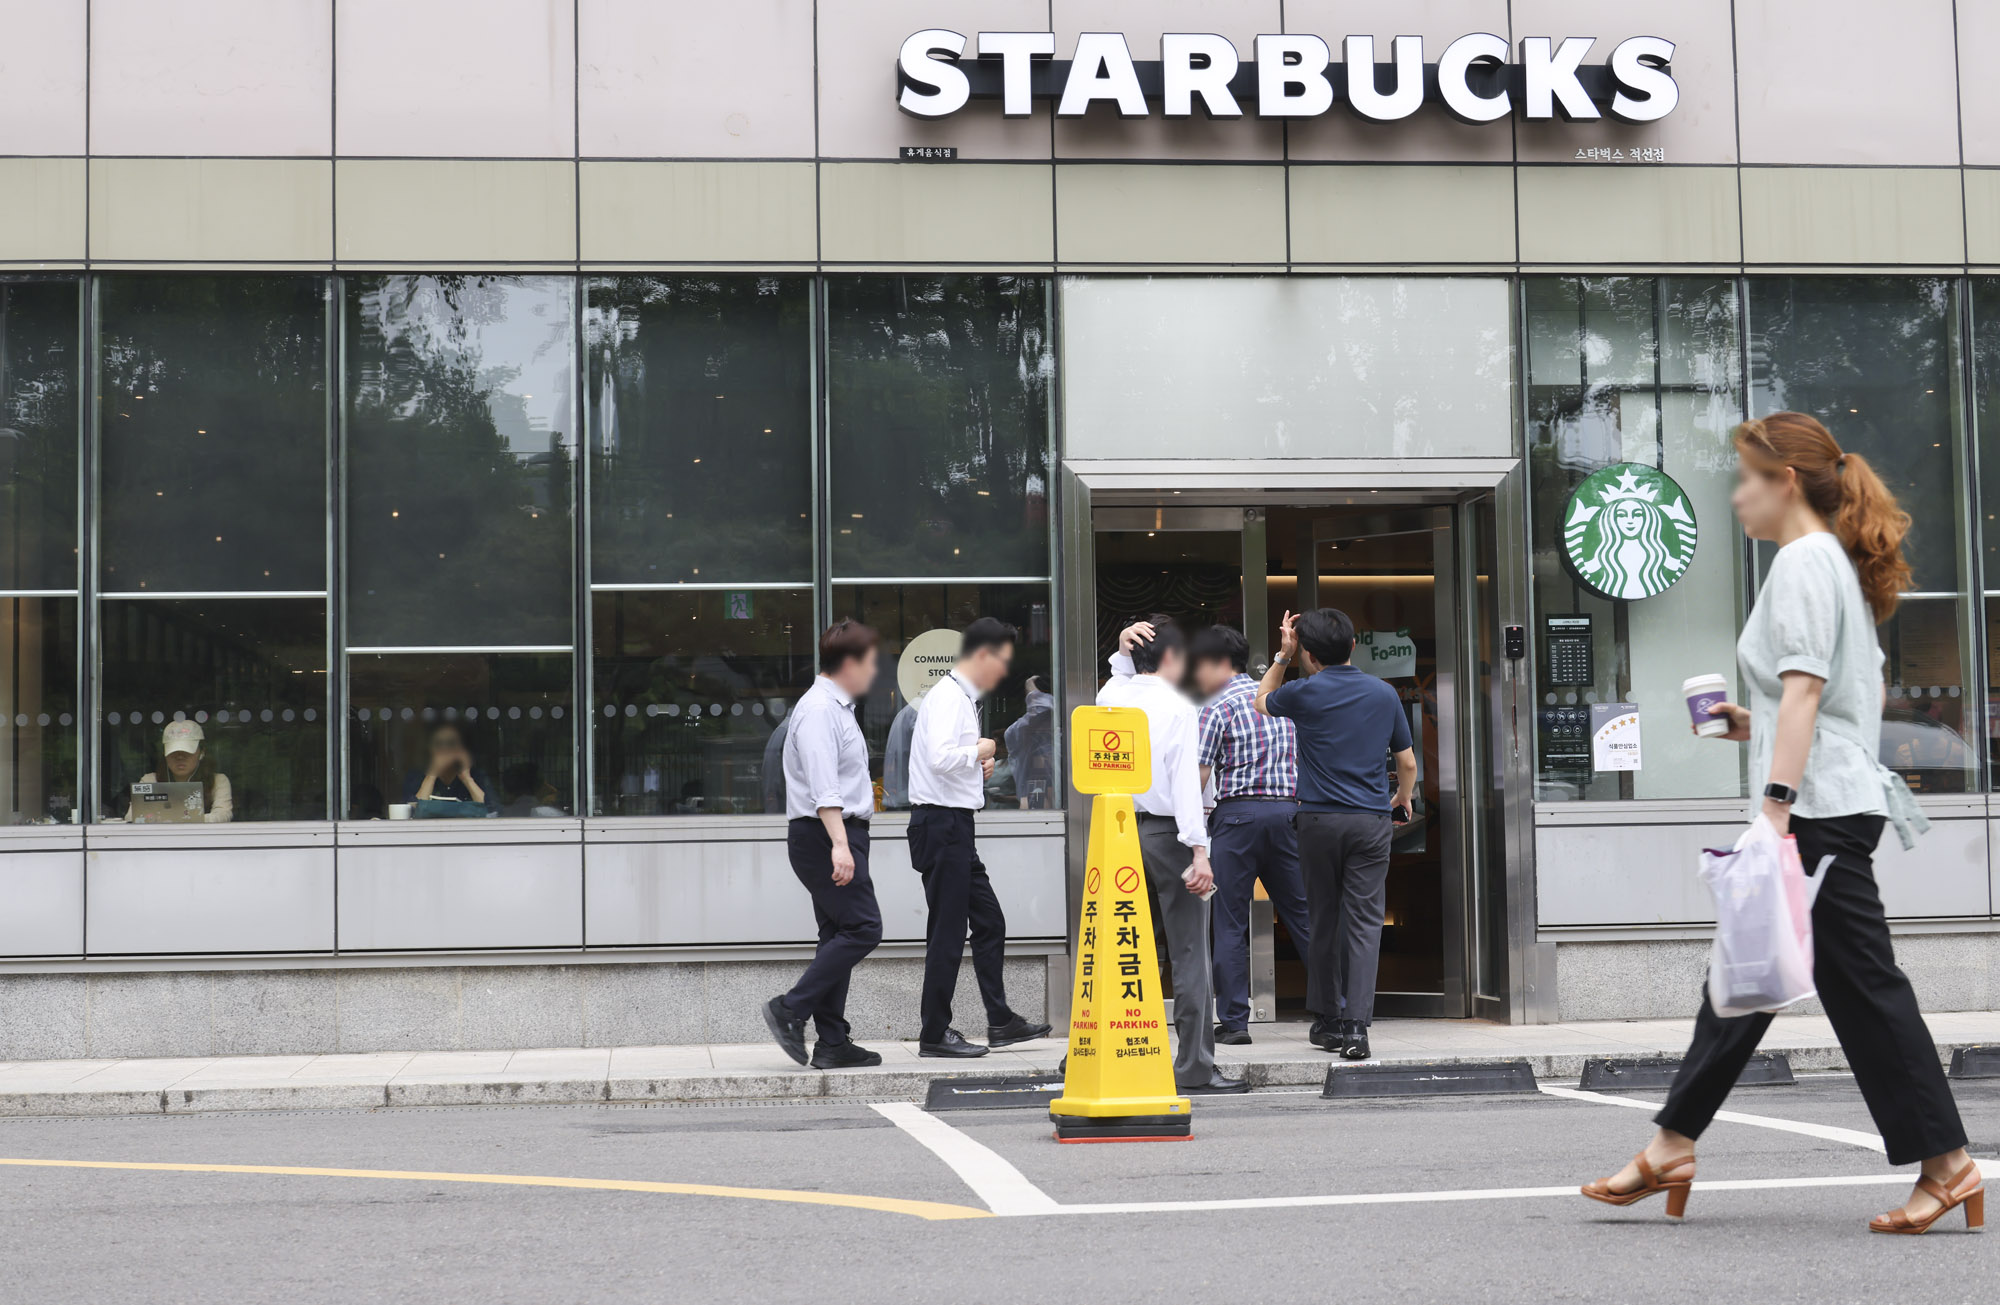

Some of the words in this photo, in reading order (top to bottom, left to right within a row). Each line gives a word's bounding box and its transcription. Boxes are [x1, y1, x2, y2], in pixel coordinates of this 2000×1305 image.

[899, 28, 1679, 123] STARBUCKS
[906, 147, 951, 158] 휴게음식점
[1574, 147, 1625, 161] 스타벅스
[1629, 147, 1665, 162] 적선점
[1354, 628, 1374, 646] old
[1371, 644, 1412, 661] Foam
[928, 669, 952, 677] STOR
[1093, 752, 1130, 762] 주차금지
[1081, 901, 1098, 1003] 주차금지
[1114, 900, 1144, 1003] 주차금지
[1081, 1009, 1091, 1018] NO
[1125, 1008, 1142, 1017] NO
[1073, 1021, 1098, 1030] PARKING
[1109, 1020, 1159, 1030] PARKING
[1126, 1036, 1149, 1046] 협조에
[1115, 1046, 1161, 1058] 감사드립니다
